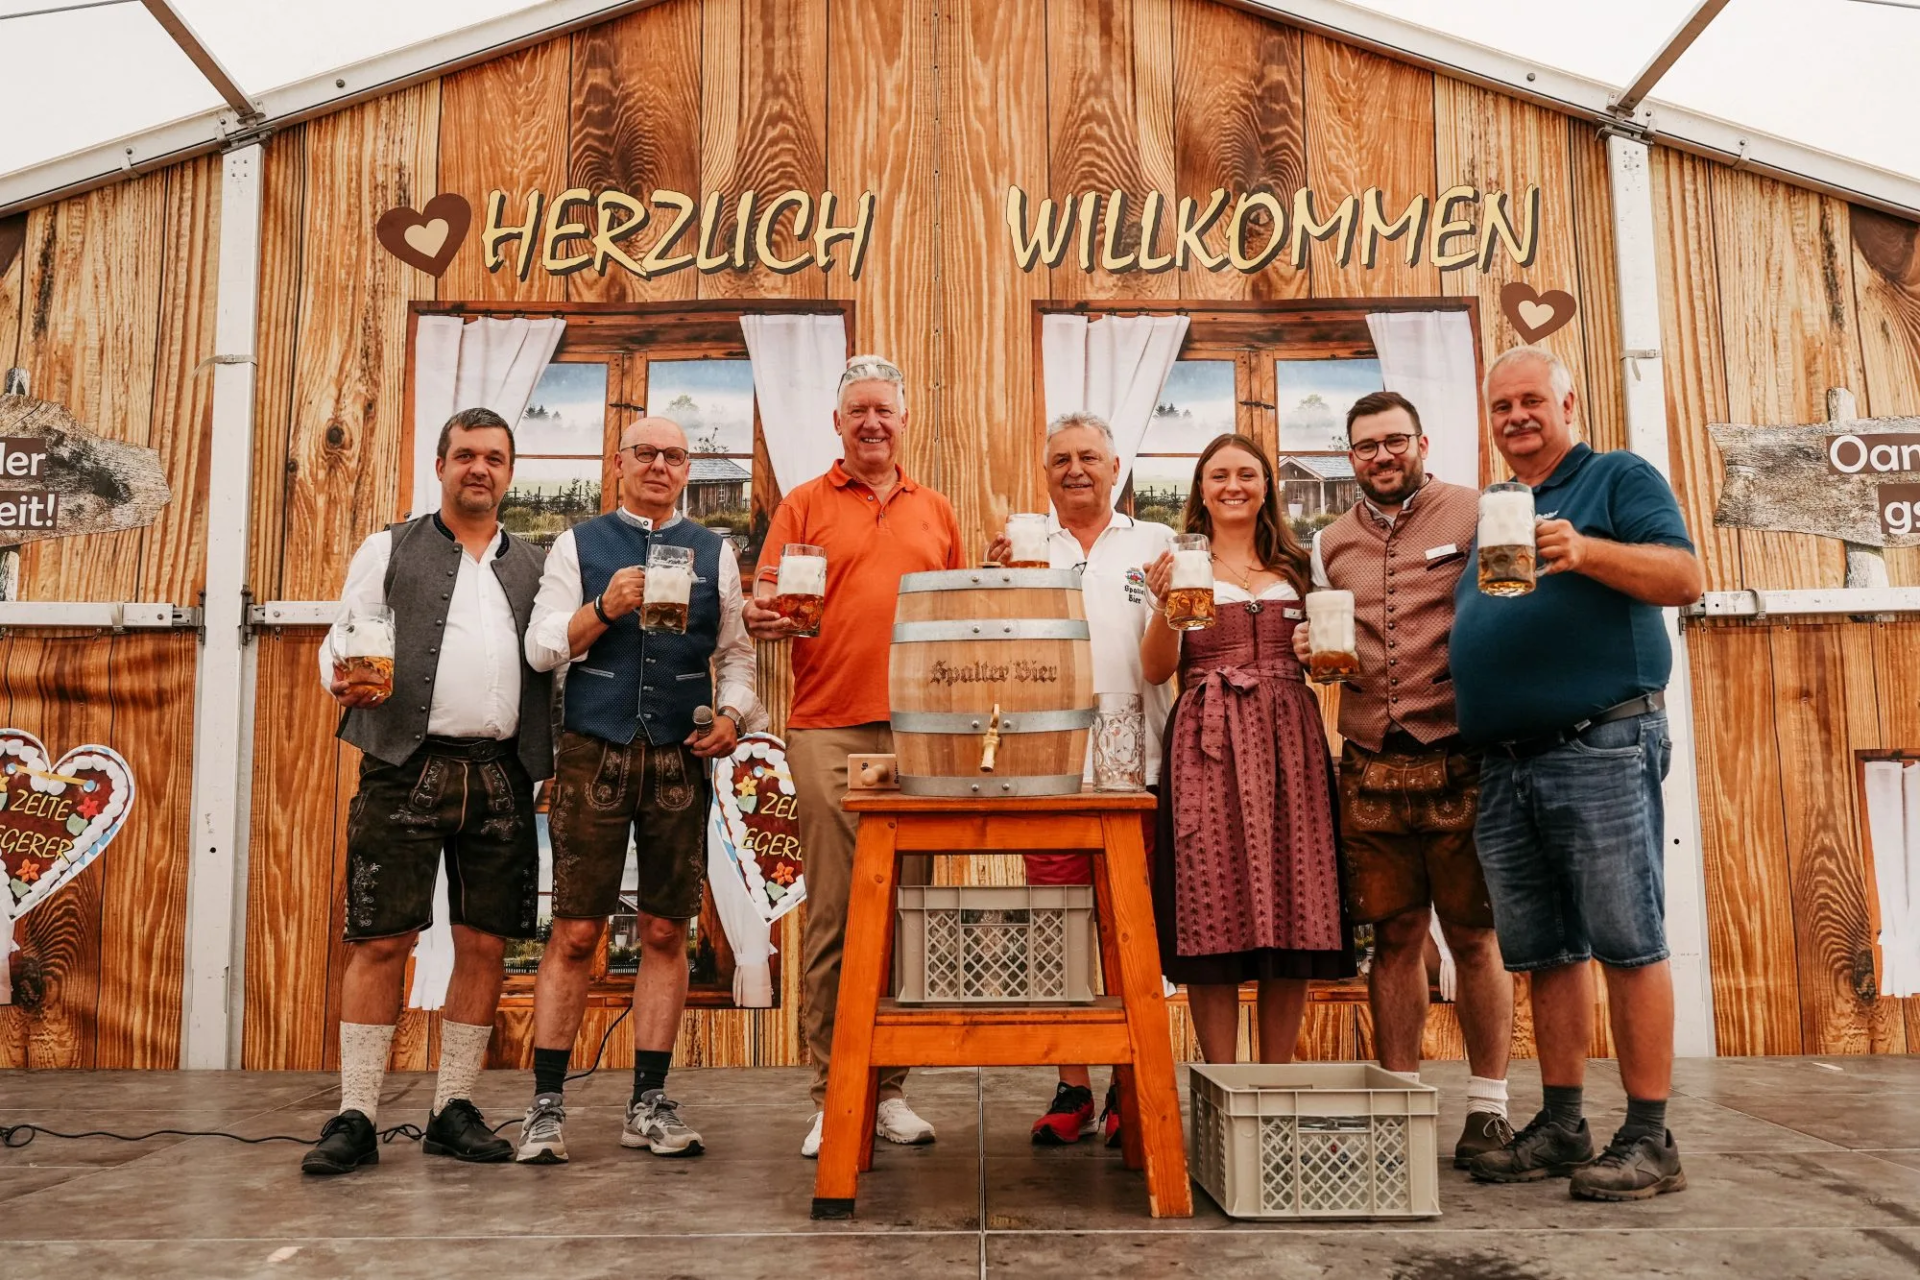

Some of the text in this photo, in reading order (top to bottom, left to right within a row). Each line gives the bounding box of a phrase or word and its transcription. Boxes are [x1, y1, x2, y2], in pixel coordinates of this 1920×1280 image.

[482, 183, 1540, 281] HERZLICH WILLKOMMEN
[930, 660, 1057, 687] Spalter Bier
[10, 789, 72, 821] ZELTE
[0, 824, 73, 864] GERER
